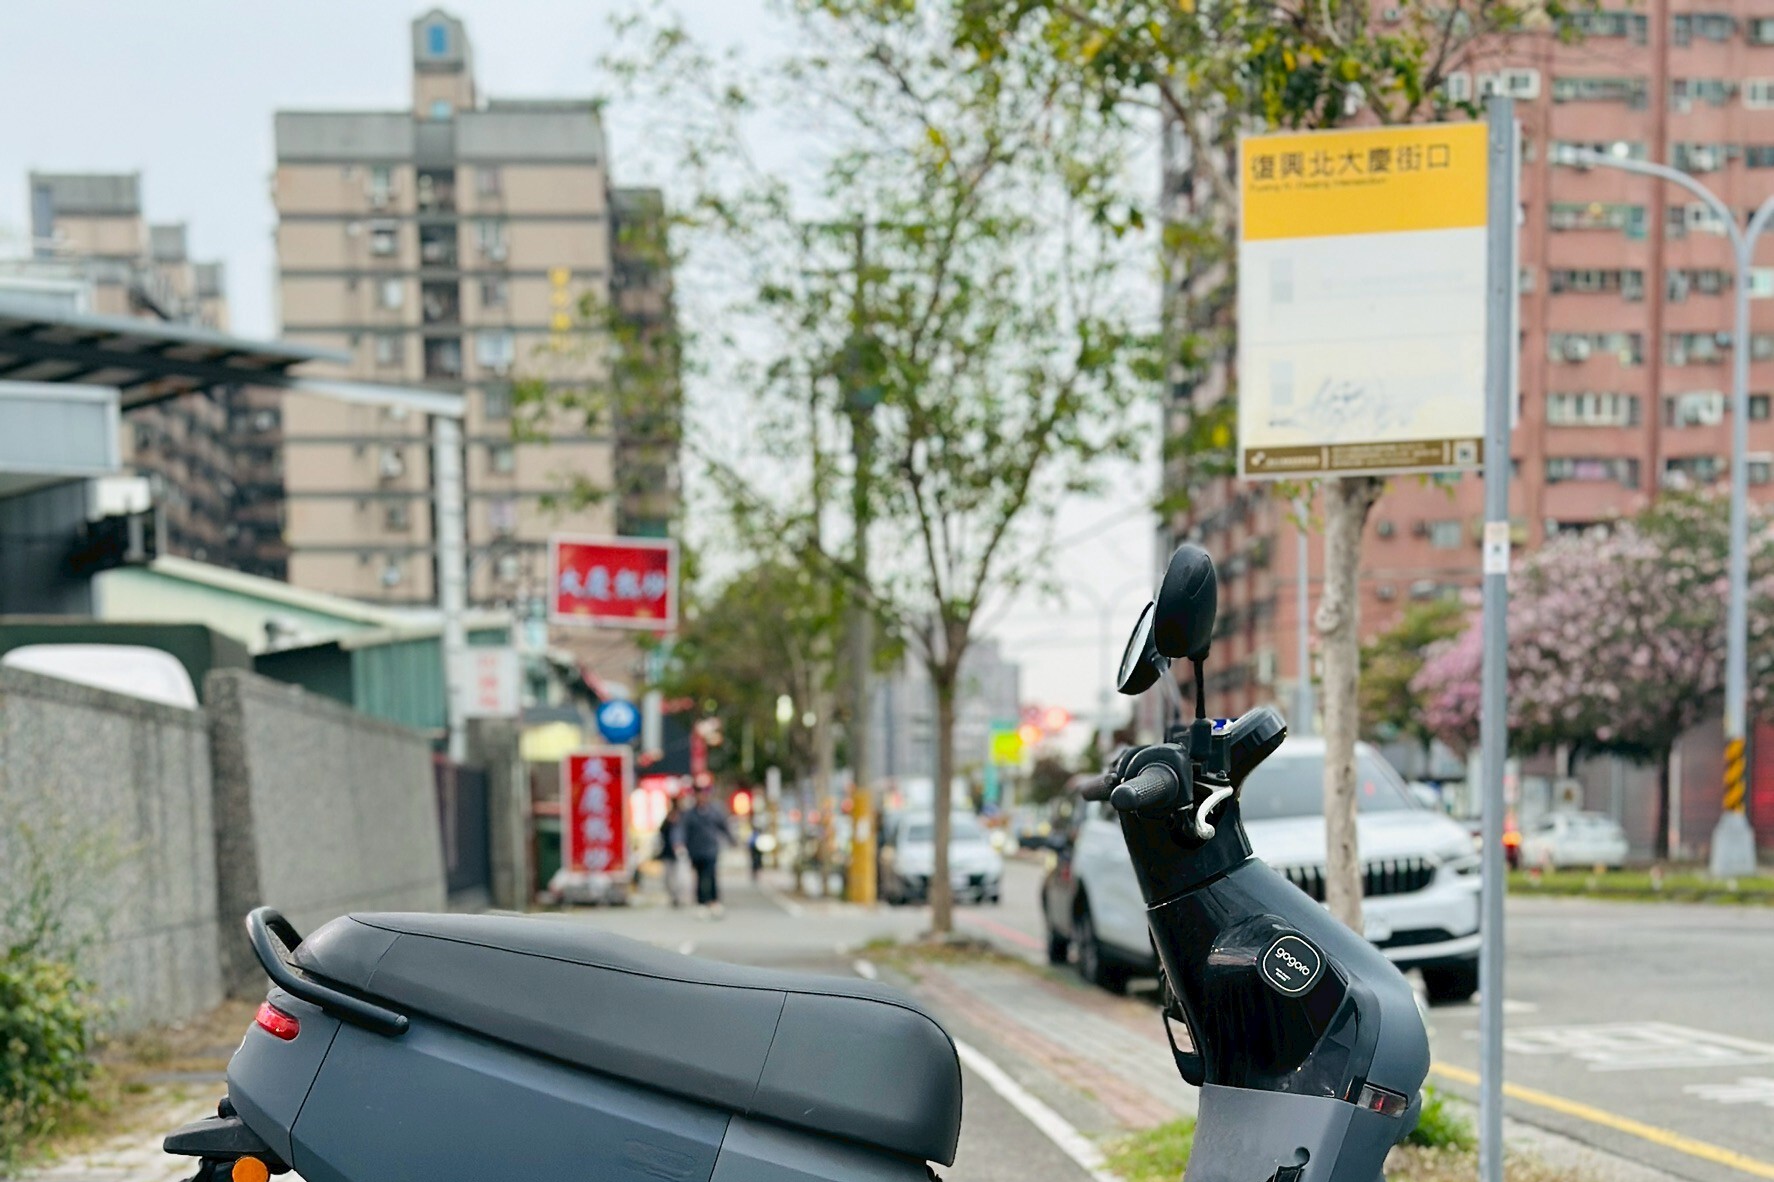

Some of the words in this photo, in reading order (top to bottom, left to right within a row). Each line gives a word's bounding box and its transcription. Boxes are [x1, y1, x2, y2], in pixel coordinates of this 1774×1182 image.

[1251, 144, 1450, 180] 復興北大慶街口
[1275, 947, 1310, 976] gogoro
